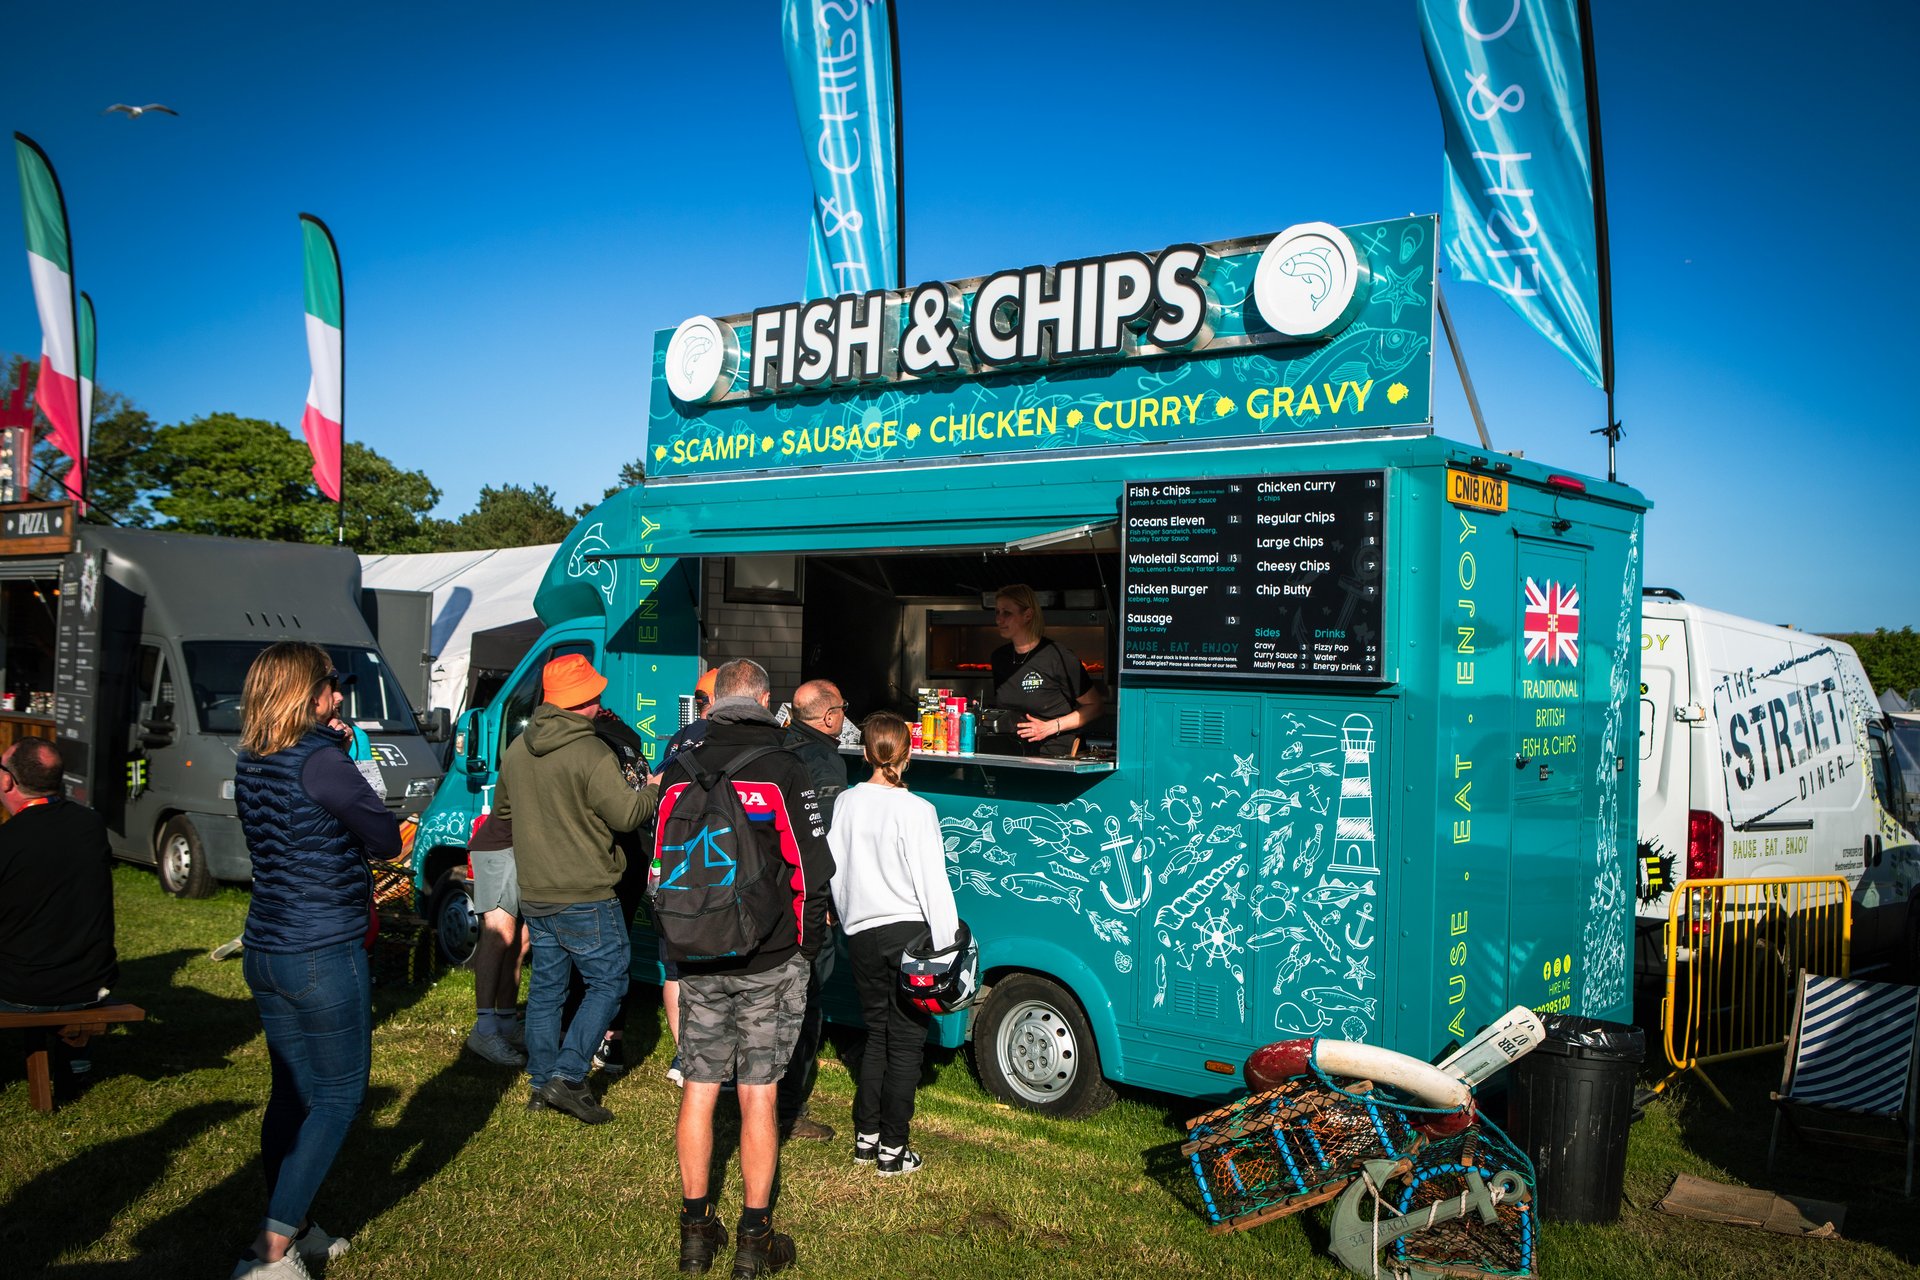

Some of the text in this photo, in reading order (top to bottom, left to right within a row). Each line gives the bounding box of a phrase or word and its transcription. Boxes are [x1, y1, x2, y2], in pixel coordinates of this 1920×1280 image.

[751, 245, 1207, 389] FISH & CHIPS
[672, 379, 1375, 465] SCAMPI SAUSAGE CHICKEN CURRY GRAVY
[1130, 487, 1149, 497] Fish
[1152, 487, 1160, 496] &
[1163, 485, 1191, 497] Chips
[1230, 485, 1239, 493] 14
[1257, 481, 1336, 493] Chicken Curry
[1455, 475, 1503, 507] CN18 KXB
[1130, 516, 1205, 527] Oceans Eleven
[1230, 515, 1238, 524] 12
[1257, 511, 1335, 526] Regular Chips
[1368, 512, 1373, 521] 5
[18, 512, 50, 535] PIZZA
[1257, 536, 1324, 550] Large Chips
[1369, 537, 1374, 545] 8
[1129, 552, 1219, 565] Wholetail Scampi
[1230, 554, 1237, 563] 13
[1257, 560, 1330, 573] Cheesy Chips
[1128, 584, 1208, 596] Chicken Burger
[1229, 586, 1237, 594] 12
[1256, 584, 1311, 597] Chip Butty
[1128, 613, 1173, 625] Sausage
[1255, 628, 1280, 637] Sides
[1315, 629, 1345, 638] Drinks
[1126, 641, 1239, 653] PAUSE EAT ENJOY
[1254, 642, 1275, 650] Gravy
[1314, 644, 1349, 652] Fizzy Pop
[1254, 652, 1274, 660] Curry
[1253, 662, 1275, 670] Mushy
[1313, 663, 1361, 672] Energy Drink
[1522, 678, 1579, 699] TRADITIONAL
[1724, 667, 1757, 704] THE
[1536, 708, 1566, 728] BRITISH
[637, 692, 657, 760] EAT
[1730, 677, 1842, 791] STREET
[1522, 734, 1577, 758] FISH & CHIPS
[1448, 512, 1477, 1038] AUSE EAT ENJOY
[1798, 755, 1845, 801] DINER
[1733, 836, 1808, 859] PAUSE EAT ENJOY
[1548, 977, 1571, 996] HIRE ME
[1512, 1034, 1530, 1046] 07
[1497, 1037, 1520, 1058] VBR
[1375, 1216, 1410, 1238] EACH
